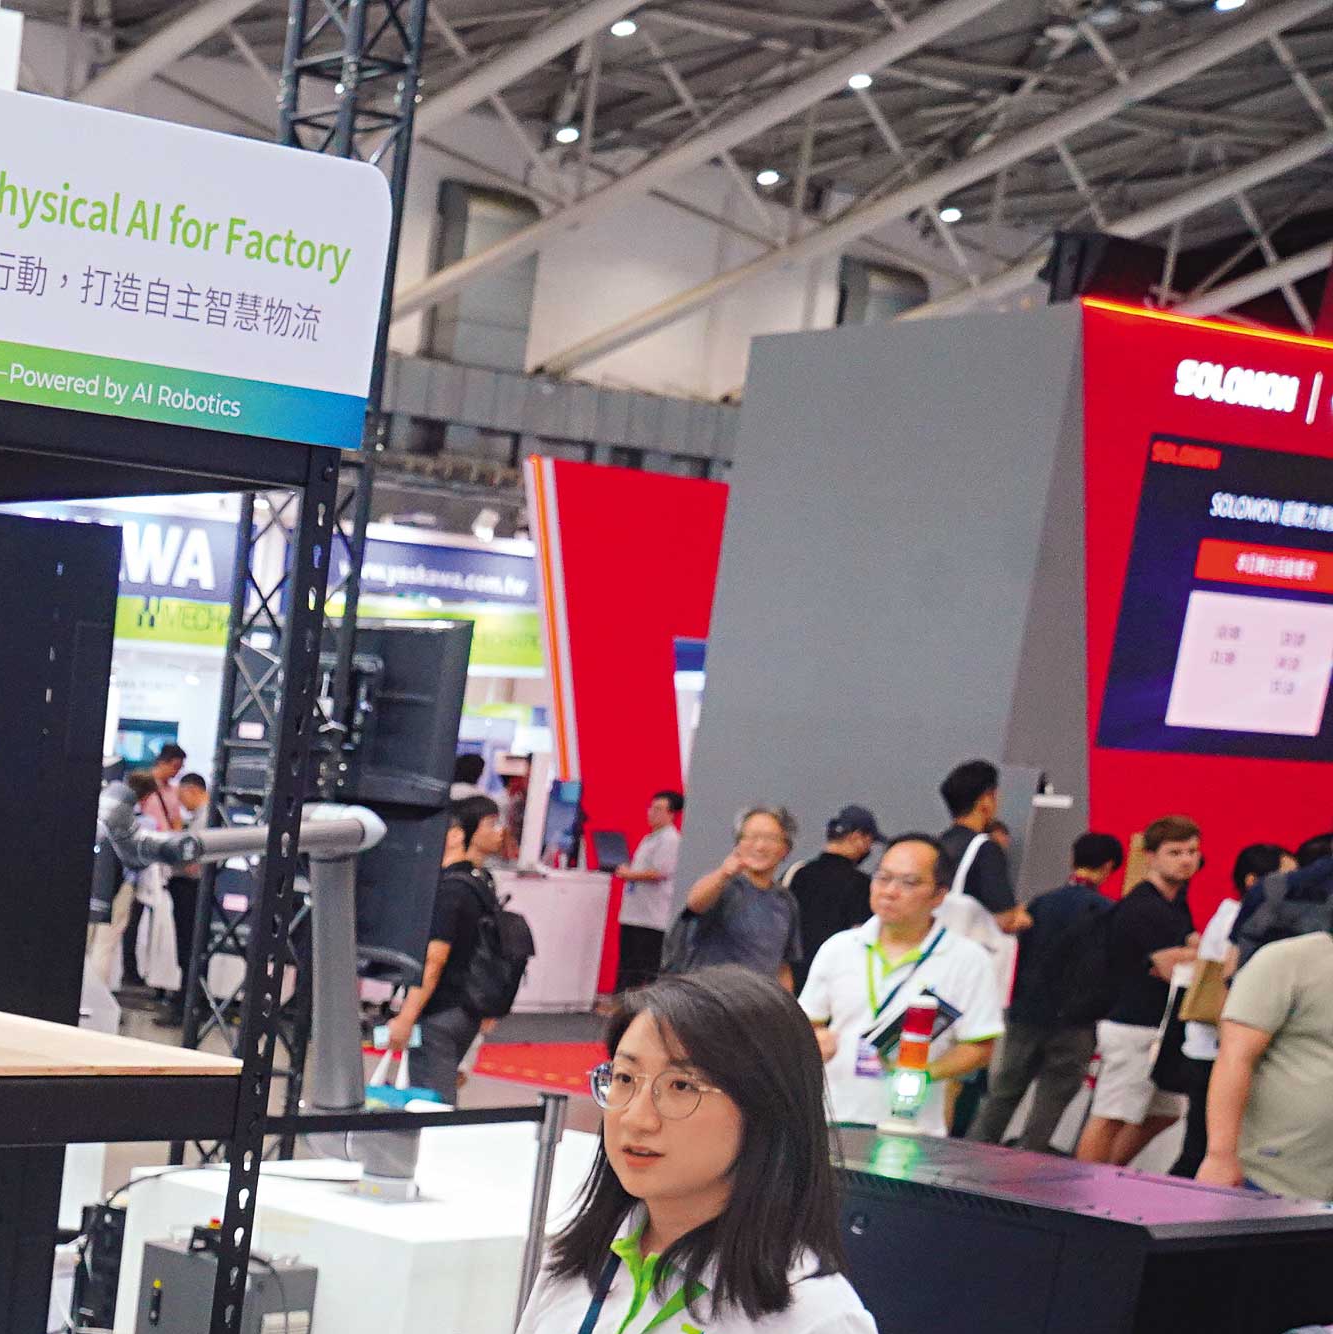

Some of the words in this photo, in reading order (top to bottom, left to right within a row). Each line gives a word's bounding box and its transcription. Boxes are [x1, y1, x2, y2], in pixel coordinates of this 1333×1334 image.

[125, 199, 162, 242] AI
[169, 203, 221, 252] for
[225, 216, 352, 285] Factory
[103, 375, 129, 406] by
[131, 383, 155, 405] AI
[157, 385, 242, 419] Robotics
[1173, 357, 1301, 414] SOLOMON
